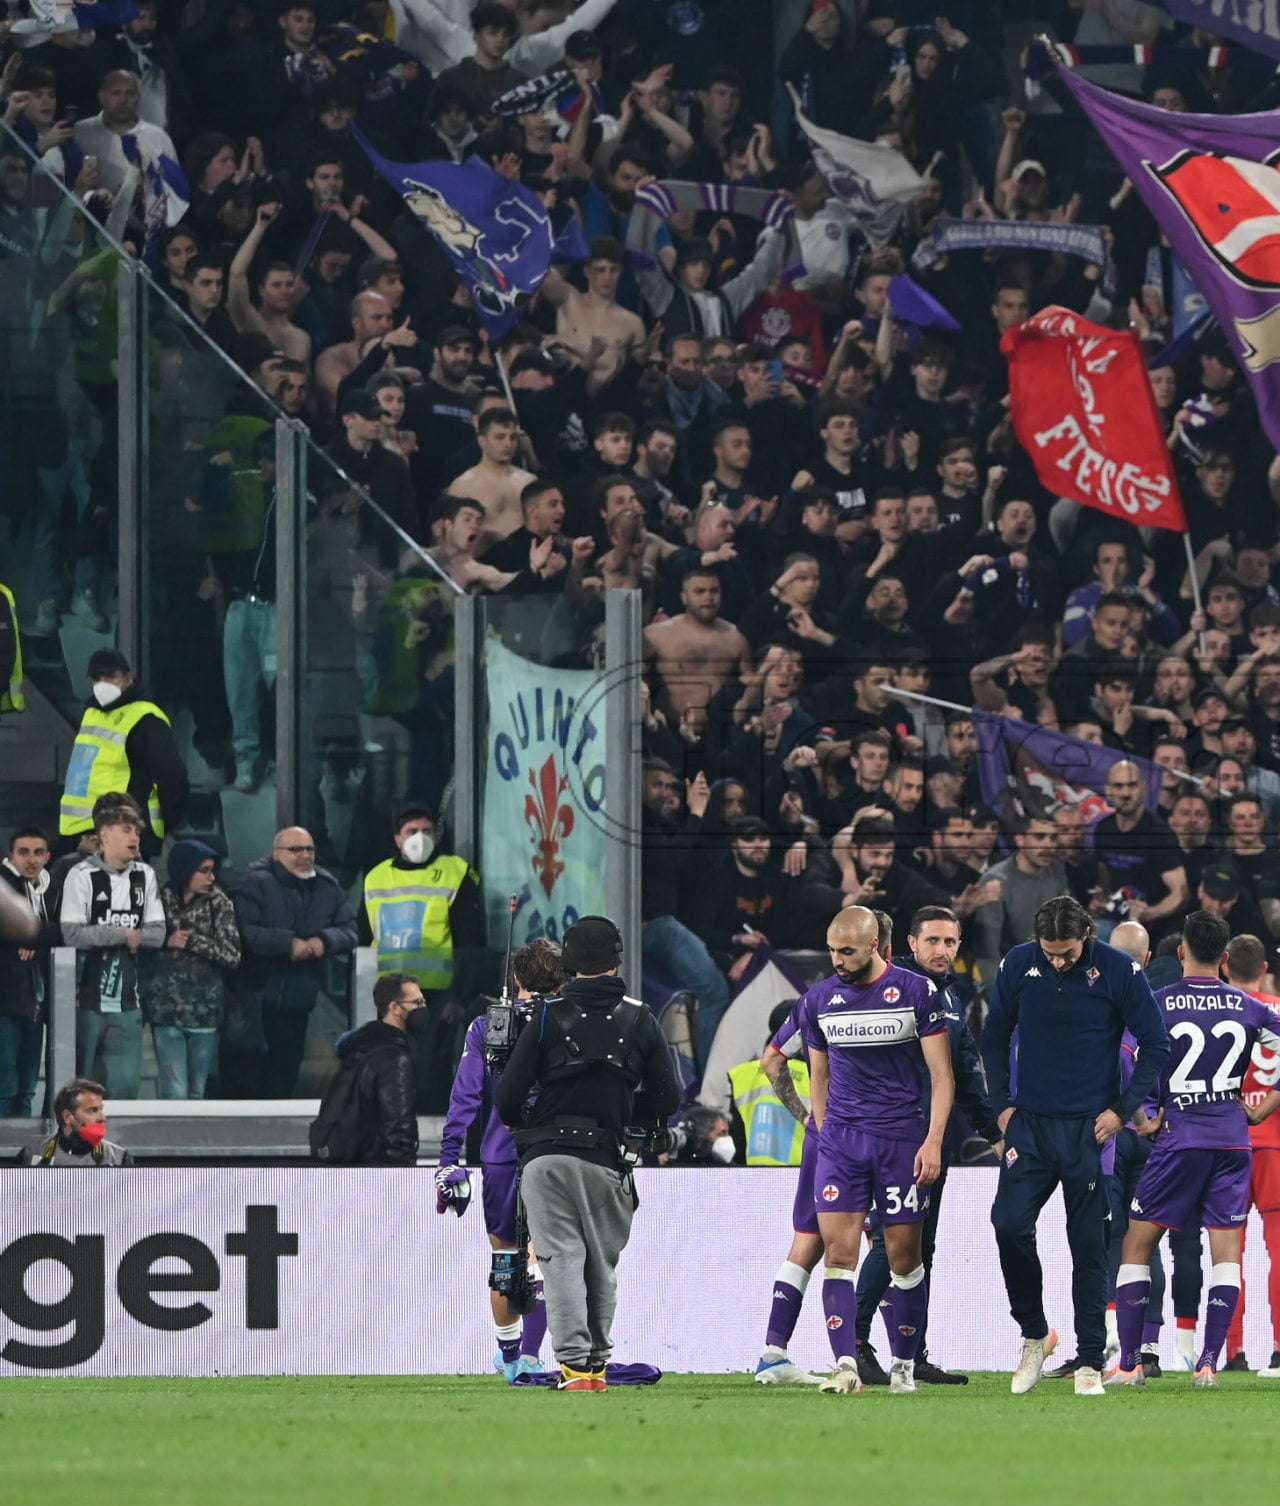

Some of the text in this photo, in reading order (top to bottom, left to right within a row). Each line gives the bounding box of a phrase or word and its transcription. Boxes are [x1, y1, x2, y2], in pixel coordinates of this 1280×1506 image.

[495, 687, 607, 813] QUINTO
[98, 909, 140, 929] Jeep
[1165, 995, 1244, 1011] GONZALEZ
[827, 1024, 896, 1038] Mediacom
[1169, 1020, 1247, 1093] 22
[886, 1184, 919, 1216] 34
[0, 1205, 298, 1369] get
